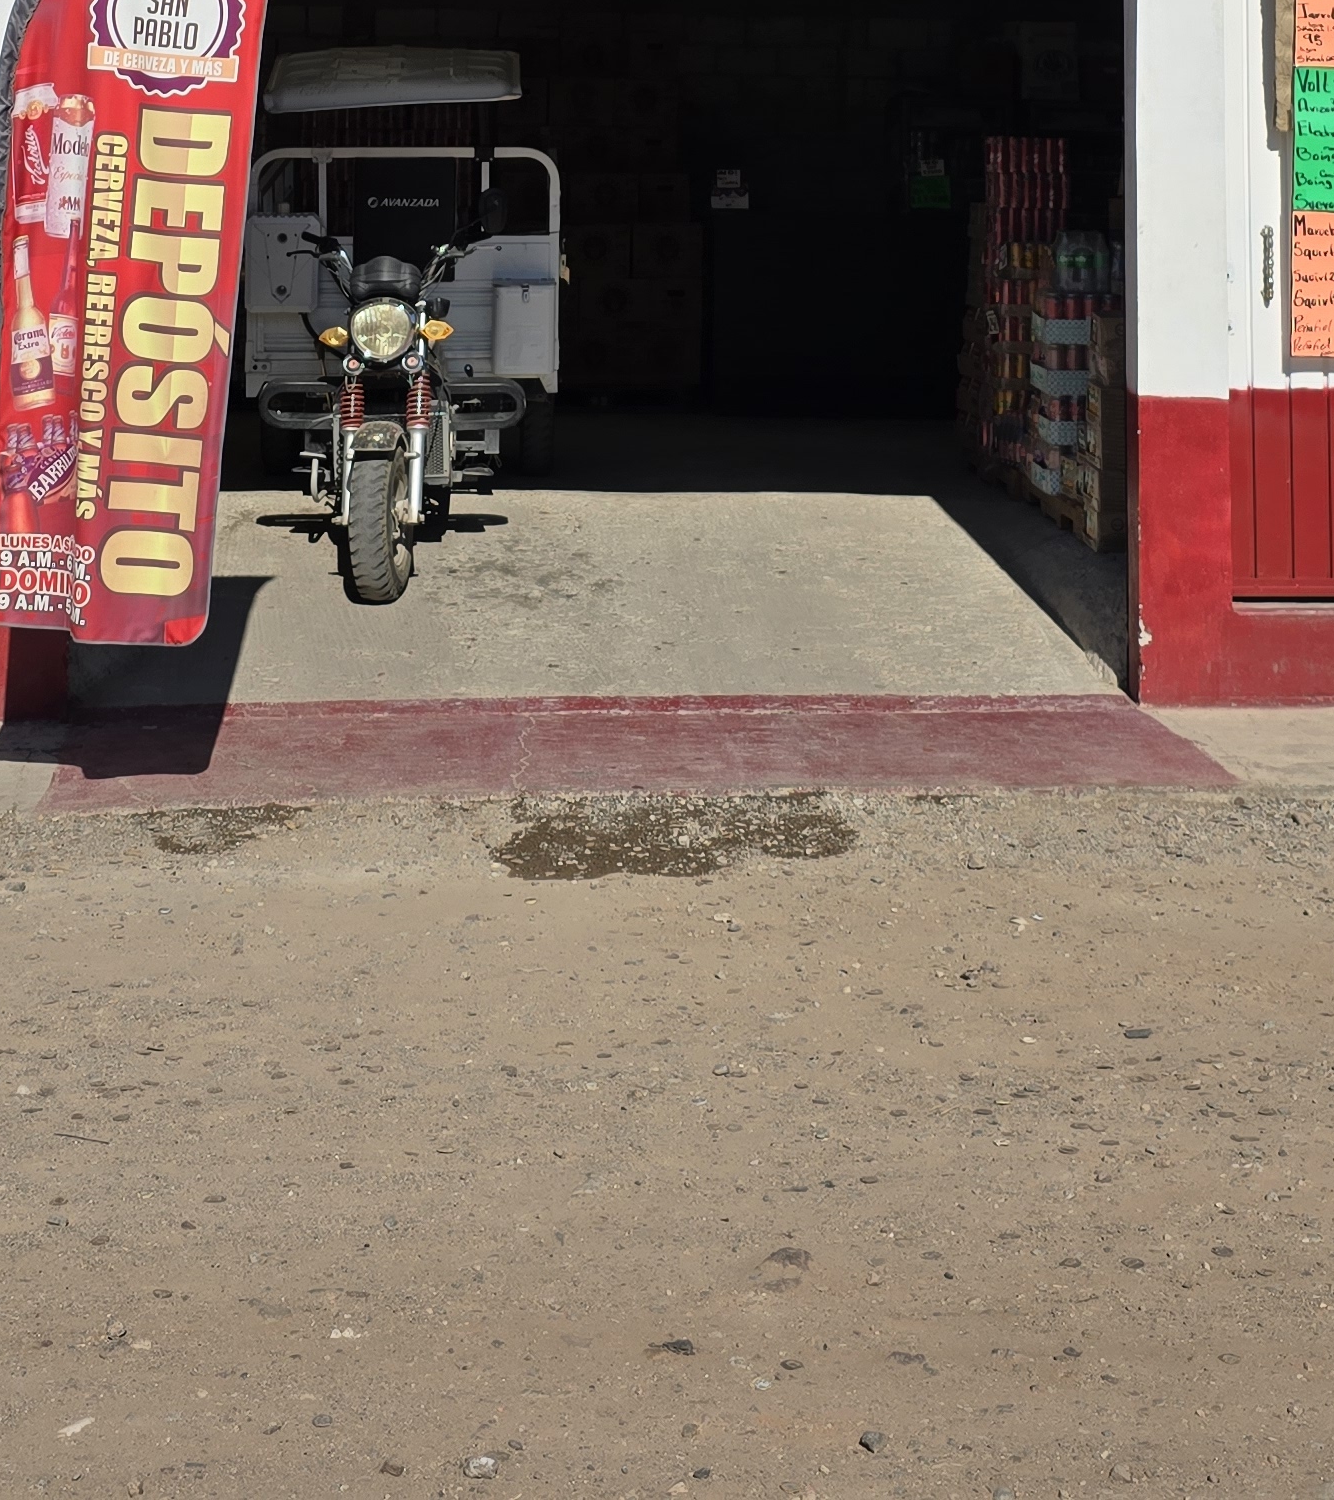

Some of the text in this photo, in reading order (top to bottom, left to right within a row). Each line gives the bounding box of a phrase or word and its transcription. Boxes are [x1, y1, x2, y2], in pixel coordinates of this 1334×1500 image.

[133, 16, 199, 50] PABLO
[103, 51, 223, 76] DE CERVEZA Y MÁS
[380, 198, 439, 207] AVANZADA
[75, 133, 128, 520] CERVEZA, REFRESCO Y MÁS
[14, 329, 46, 345] Corona
[100, 106, 233, 597] DEPÓSITO
[0, 535, 62, 551] LUNES A
[0, 551, 73, 571] 9 A.M. 6
[15, 594, 53, 611] A.M.
